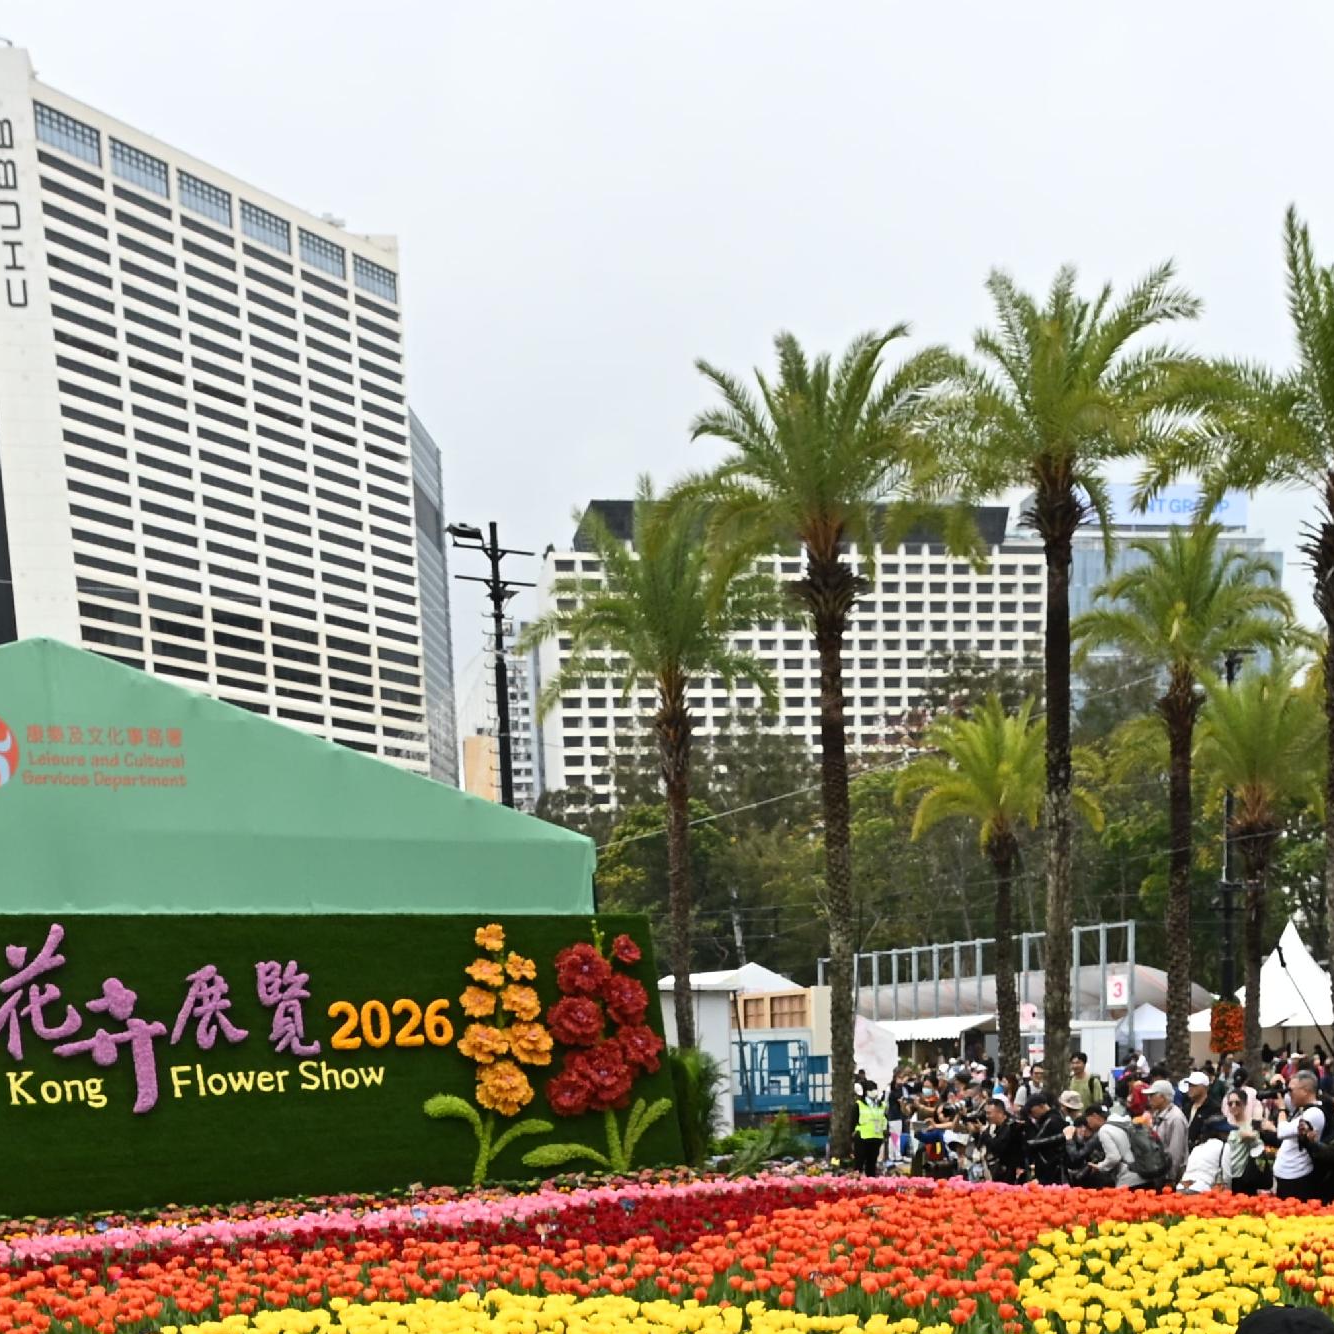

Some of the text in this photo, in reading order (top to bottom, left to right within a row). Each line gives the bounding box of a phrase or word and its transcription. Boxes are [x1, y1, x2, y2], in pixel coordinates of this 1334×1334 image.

[28, 751, 185, 768] Leisure and Cultural
[22, 770, 187, 791] Services Department
[1113, 982, 1123, 998] 3
[327, 998, 454, 1050] 2026
[5, 1070, 108, 1108] Kong
[170, 1063, 290, 1099] Flower
[298, 1060, 385, 1091] Show
